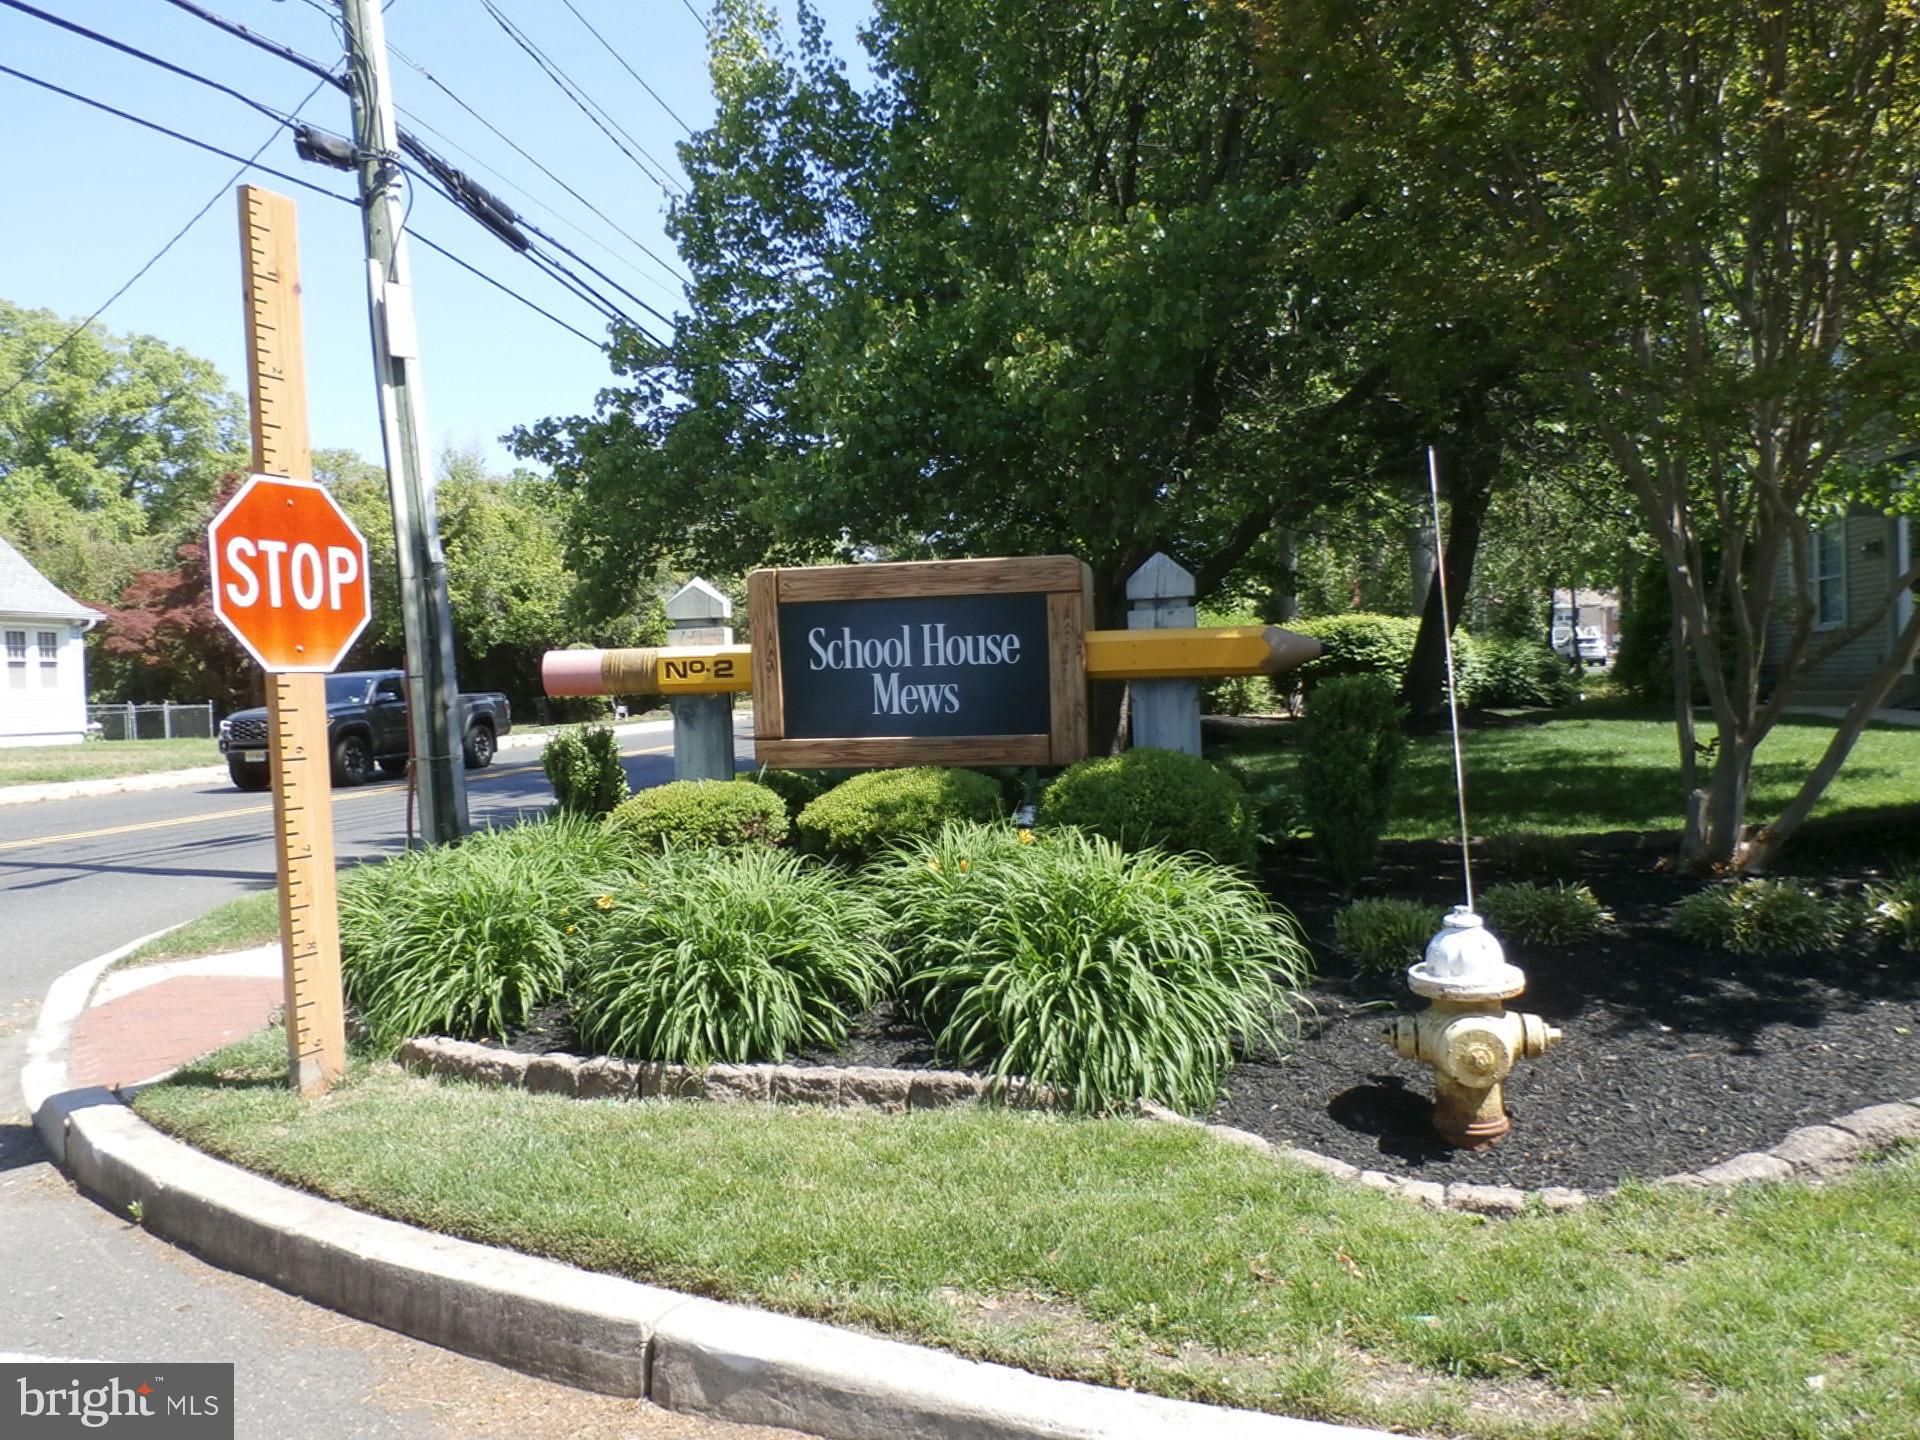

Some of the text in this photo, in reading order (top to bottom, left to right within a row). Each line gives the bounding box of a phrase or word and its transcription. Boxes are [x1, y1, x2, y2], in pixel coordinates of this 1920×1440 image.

[226, 536, 358, 611] STOP
[808, 623, 1021, 671] School House
[871, 672, 960, 715] Mews
